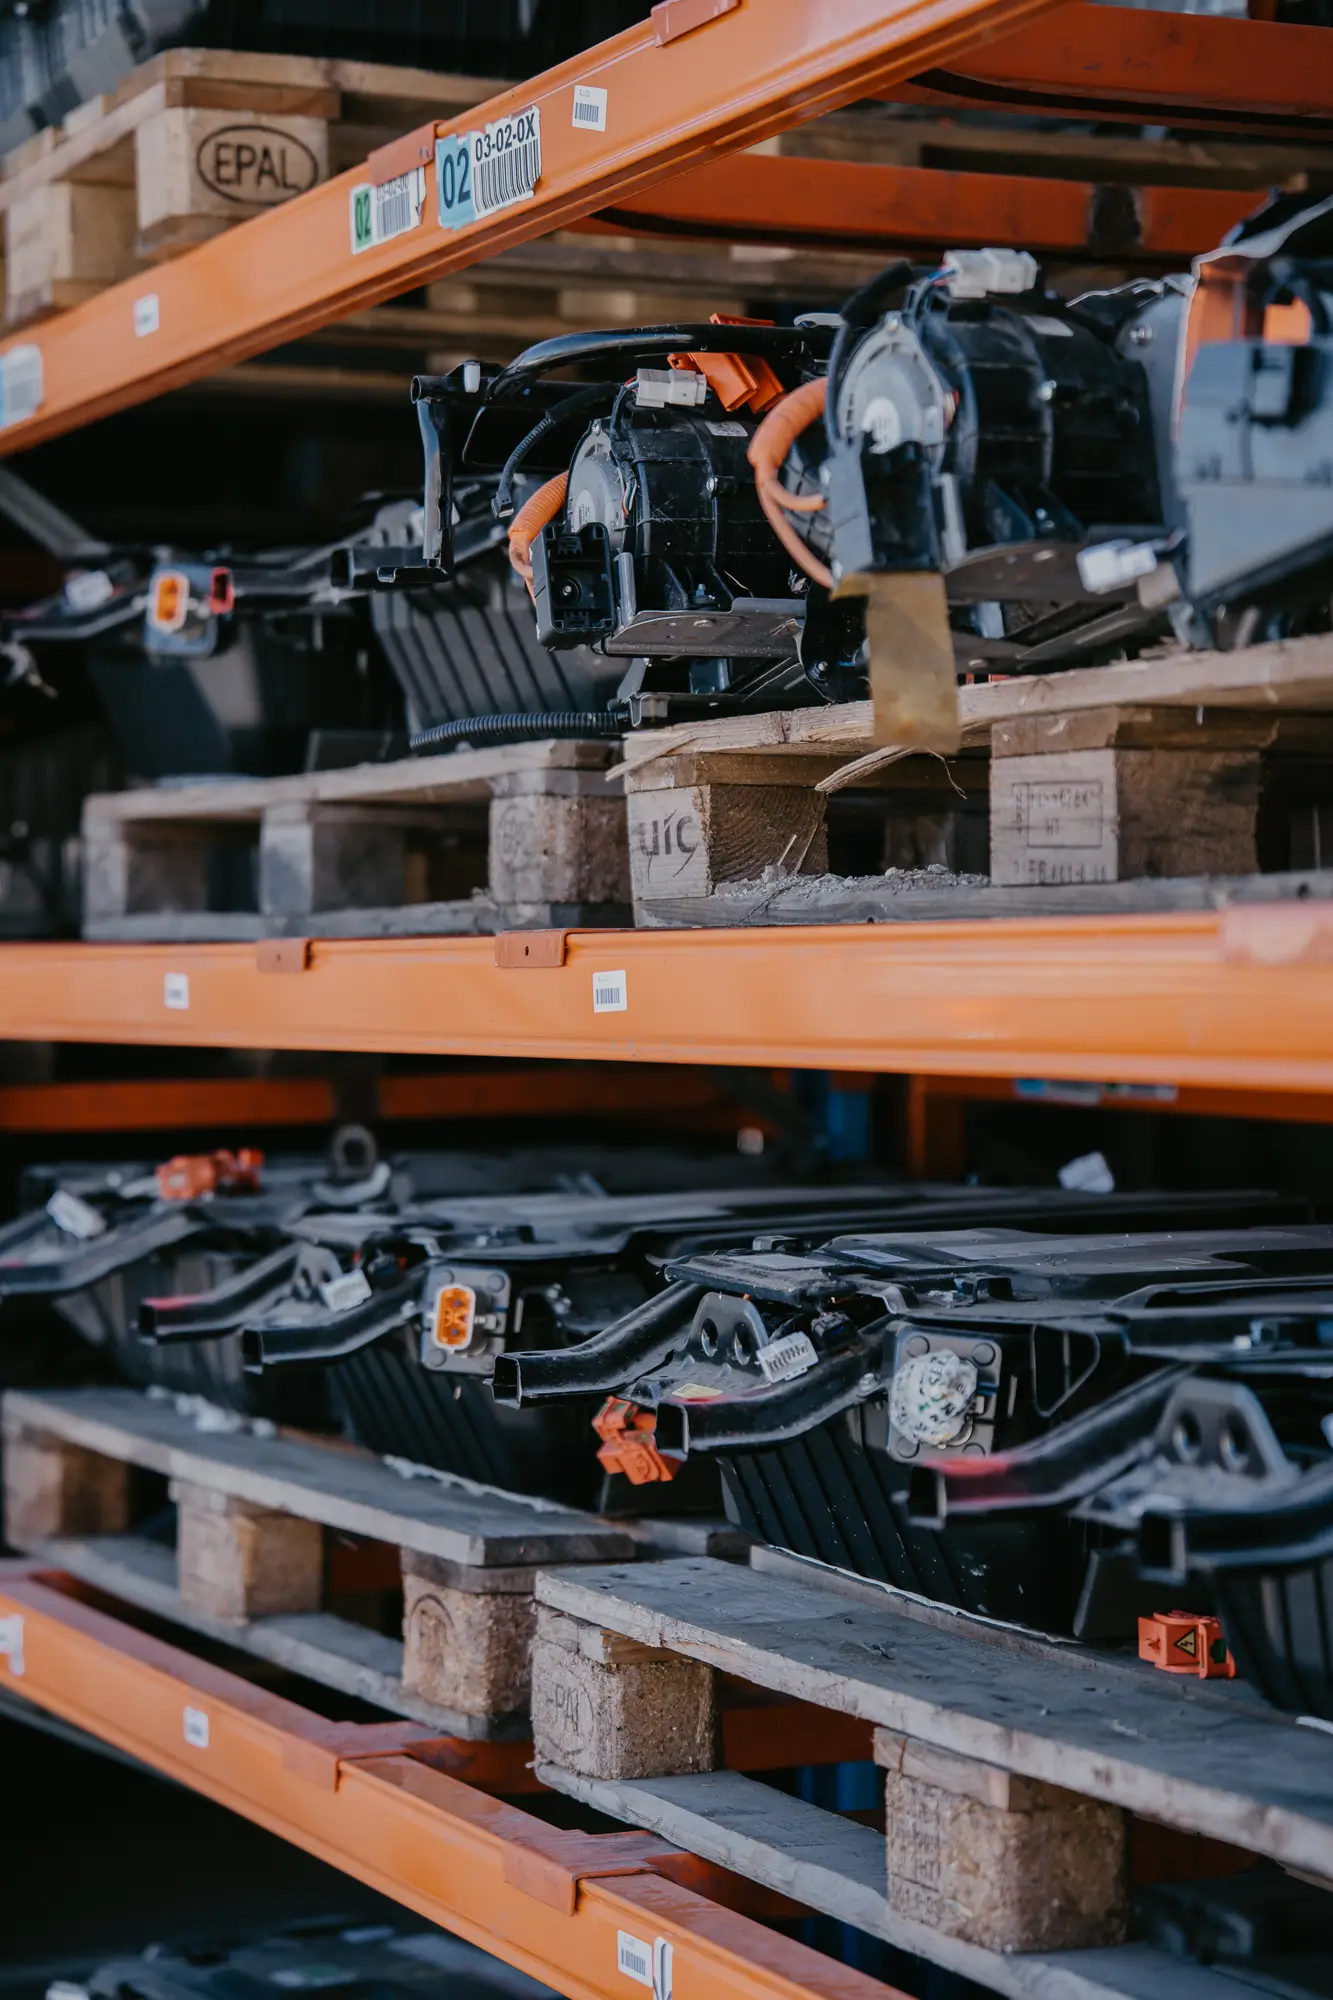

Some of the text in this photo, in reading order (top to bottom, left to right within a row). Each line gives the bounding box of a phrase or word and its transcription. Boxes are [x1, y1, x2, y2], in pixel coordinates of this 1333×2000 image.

[475, 112, 536, 161] 03-02-0X
[214, 142, 301, 190] EPAL
[443, 147, 471, 209] 02
[356, 193, 371, 241] 02
